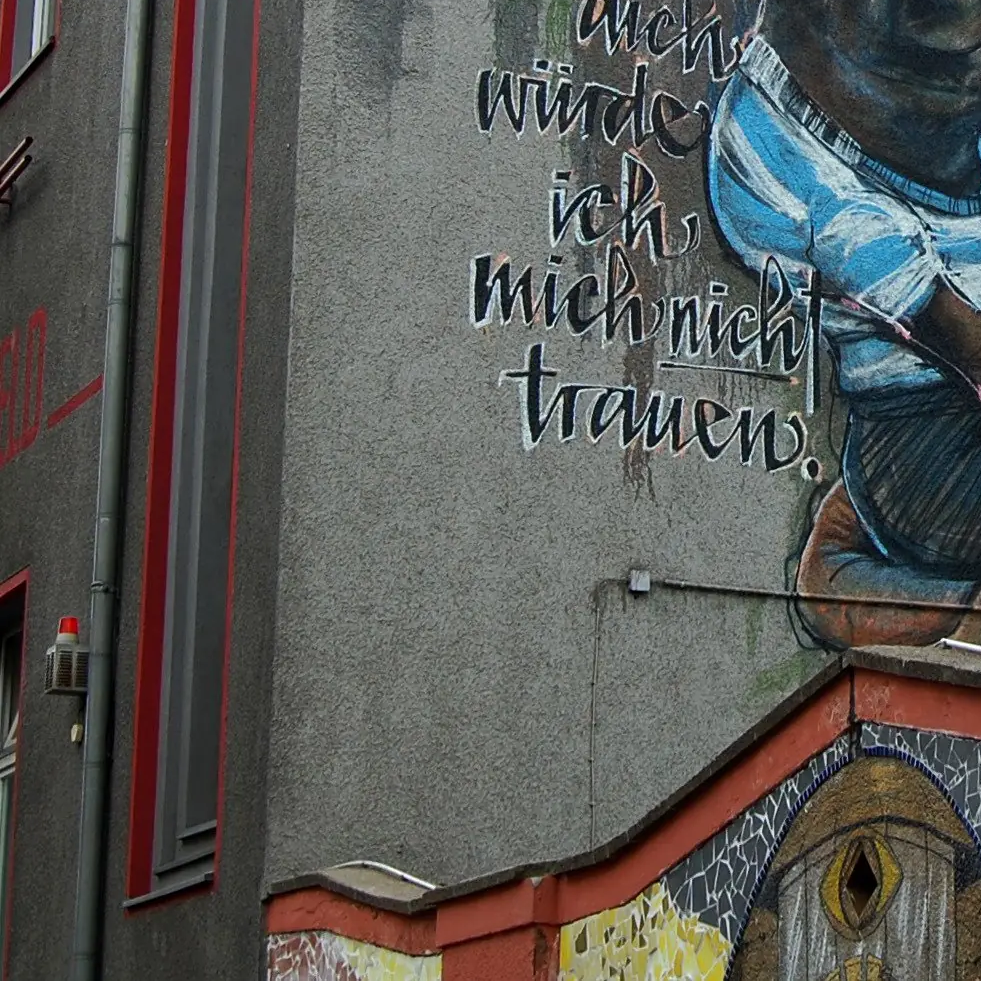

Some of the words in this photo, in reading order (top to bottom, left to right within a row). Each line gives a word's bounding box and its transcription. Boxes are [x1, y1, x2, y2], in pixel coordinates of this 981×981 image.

[477, 57, 712, 159] würde
[470, 240, 668, 349] mich
[669, 254, 823, 416] nicht
[500, 342, 823, 481] trauen.
